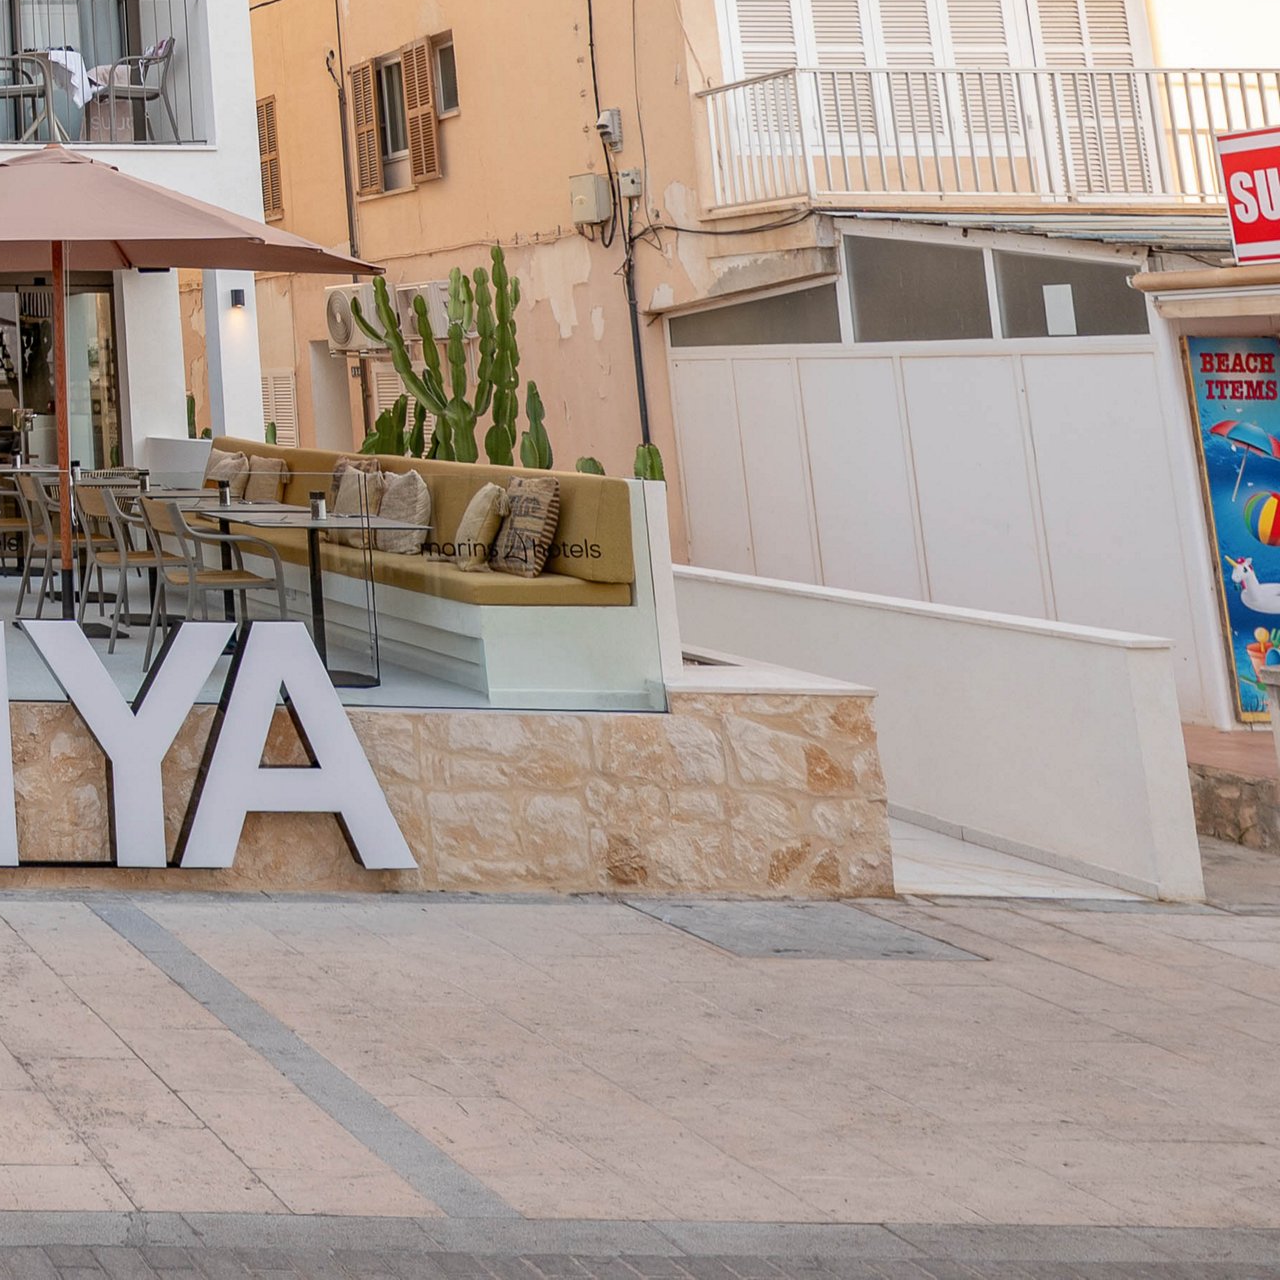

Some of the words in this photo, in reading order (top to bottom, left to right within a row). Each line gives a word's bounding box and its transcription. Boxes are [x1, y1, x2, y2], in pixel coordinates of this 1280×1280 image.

[1200, 352, 1276, 374] BEACH
[1205, 379, 1278, 401] ITEMS
[419, 538, 499, 558] marins
[532, 538, 602, 559] hotels
